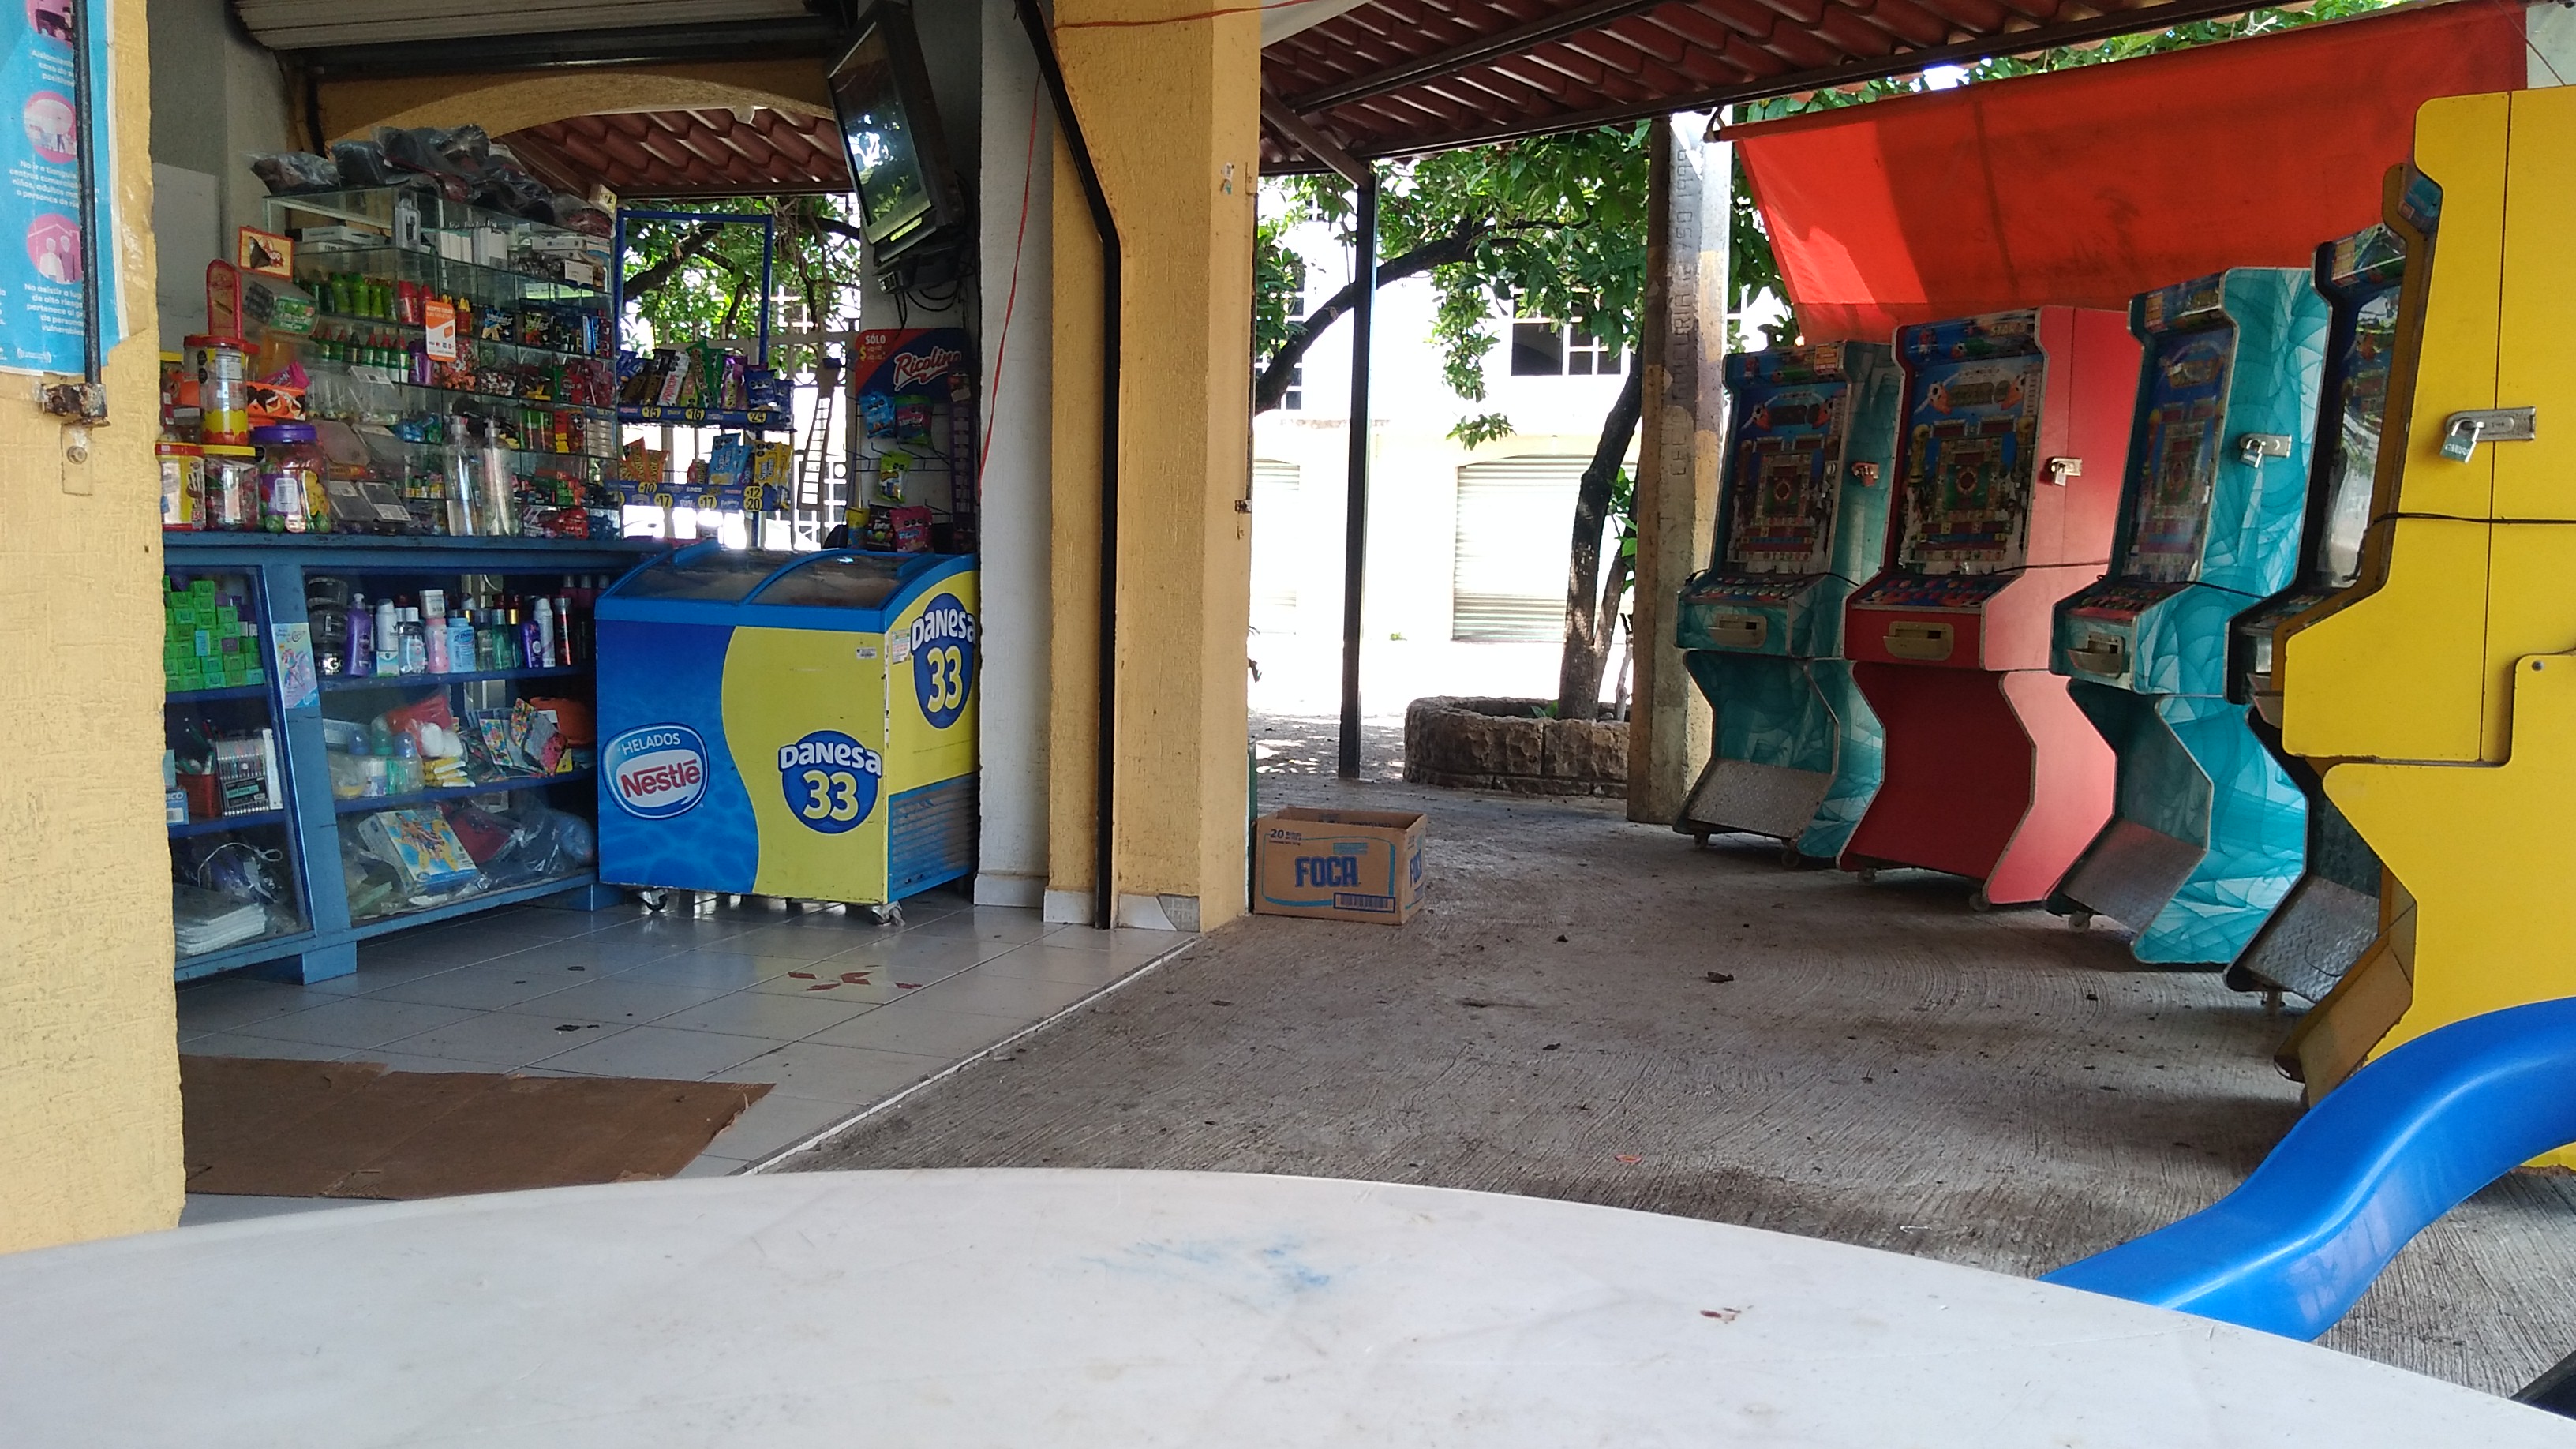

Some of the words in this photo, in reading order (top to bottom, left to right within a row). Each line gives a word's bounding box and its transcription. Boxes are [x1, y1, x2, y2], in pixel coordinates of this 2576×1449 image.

[865, 333, 886, 345] SÓLO
[927, 646, 963, 713] 33
[621, 732, 681, 755] HELADOS
[803, 769, 859, 822] 33
[1269, 829, 1284, 839] 20
[1295, 856, 1359, 888] FOCA
